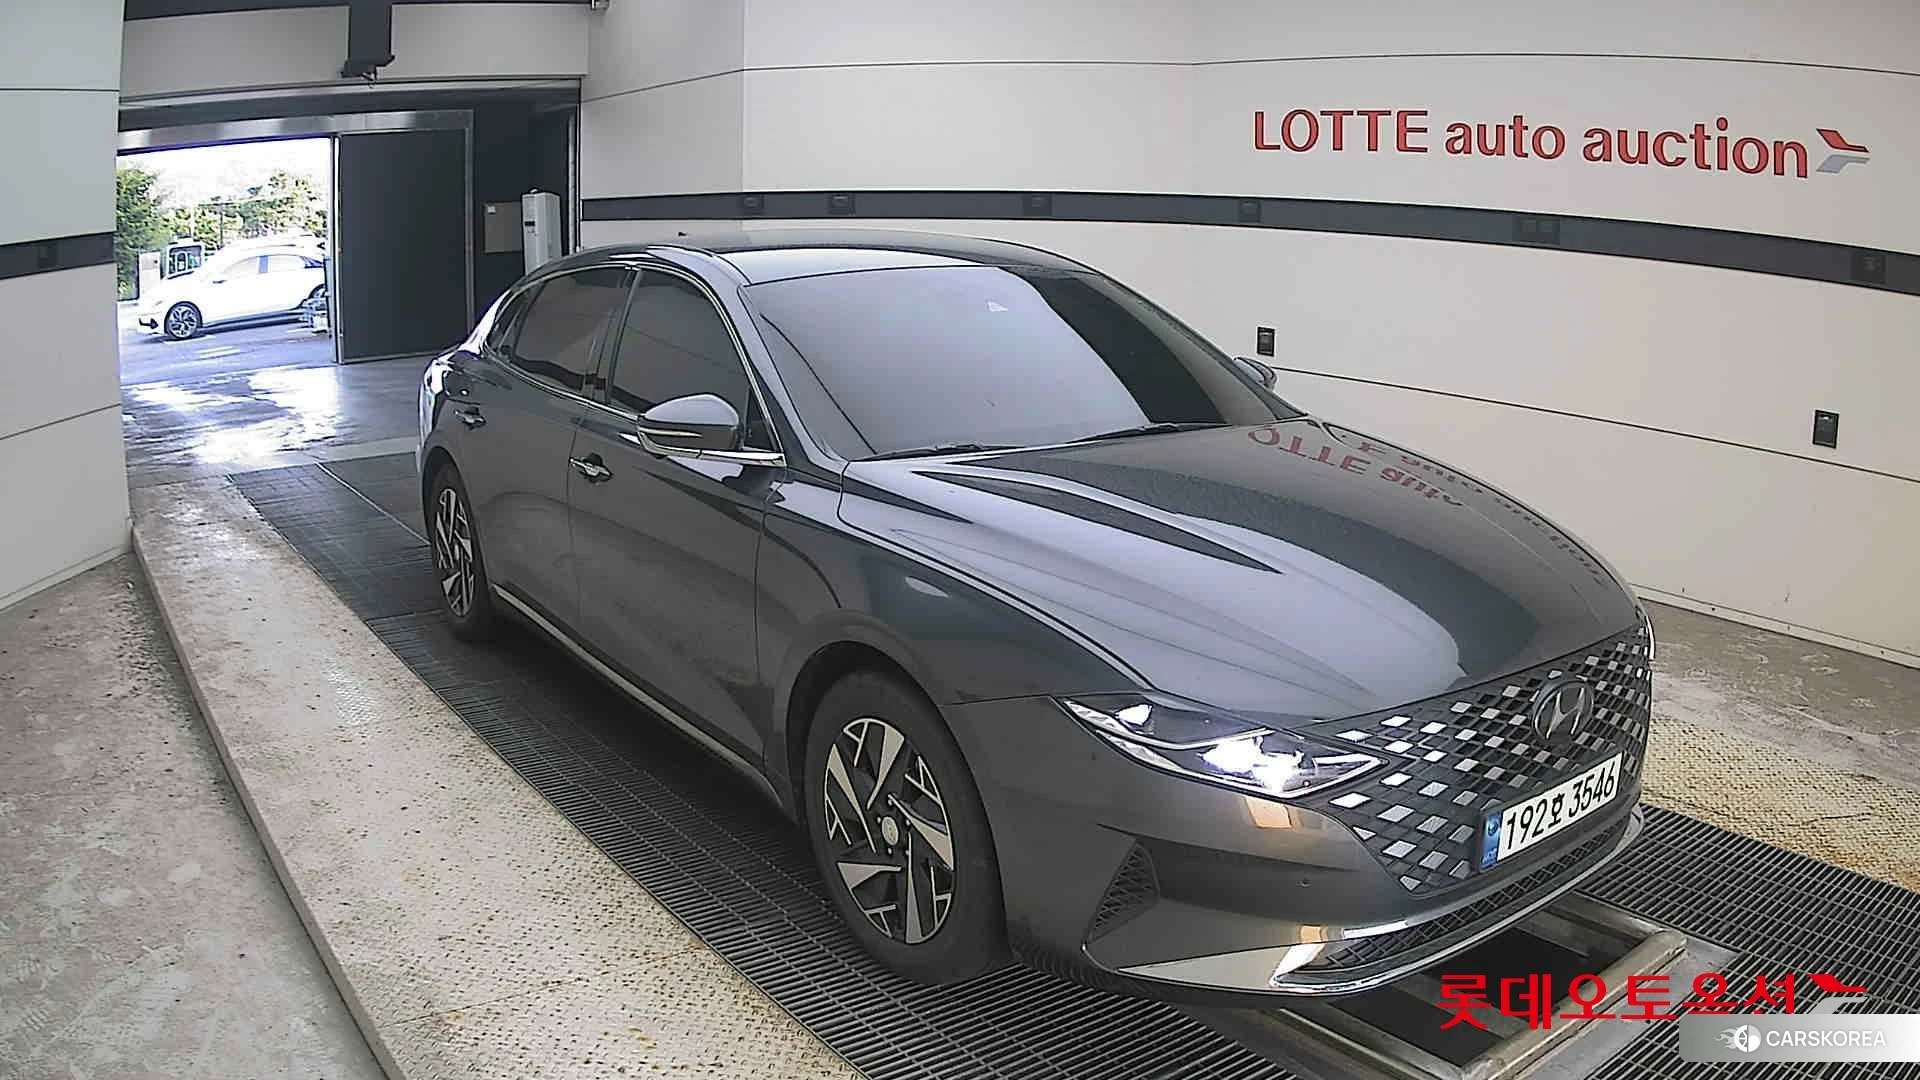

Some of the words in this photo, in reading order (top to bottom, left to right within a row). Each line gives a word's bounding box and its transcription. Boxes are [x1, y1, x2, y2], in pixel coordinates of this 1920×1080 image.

[1254, 109, 1429, 152] LOTTE
[1445, 115, 1566, 159] auto
[1582, 117, 1809, 178] auction
[1506, 792, 1566, 850] 192호
[1568, 760, 1616, 818] 3546
